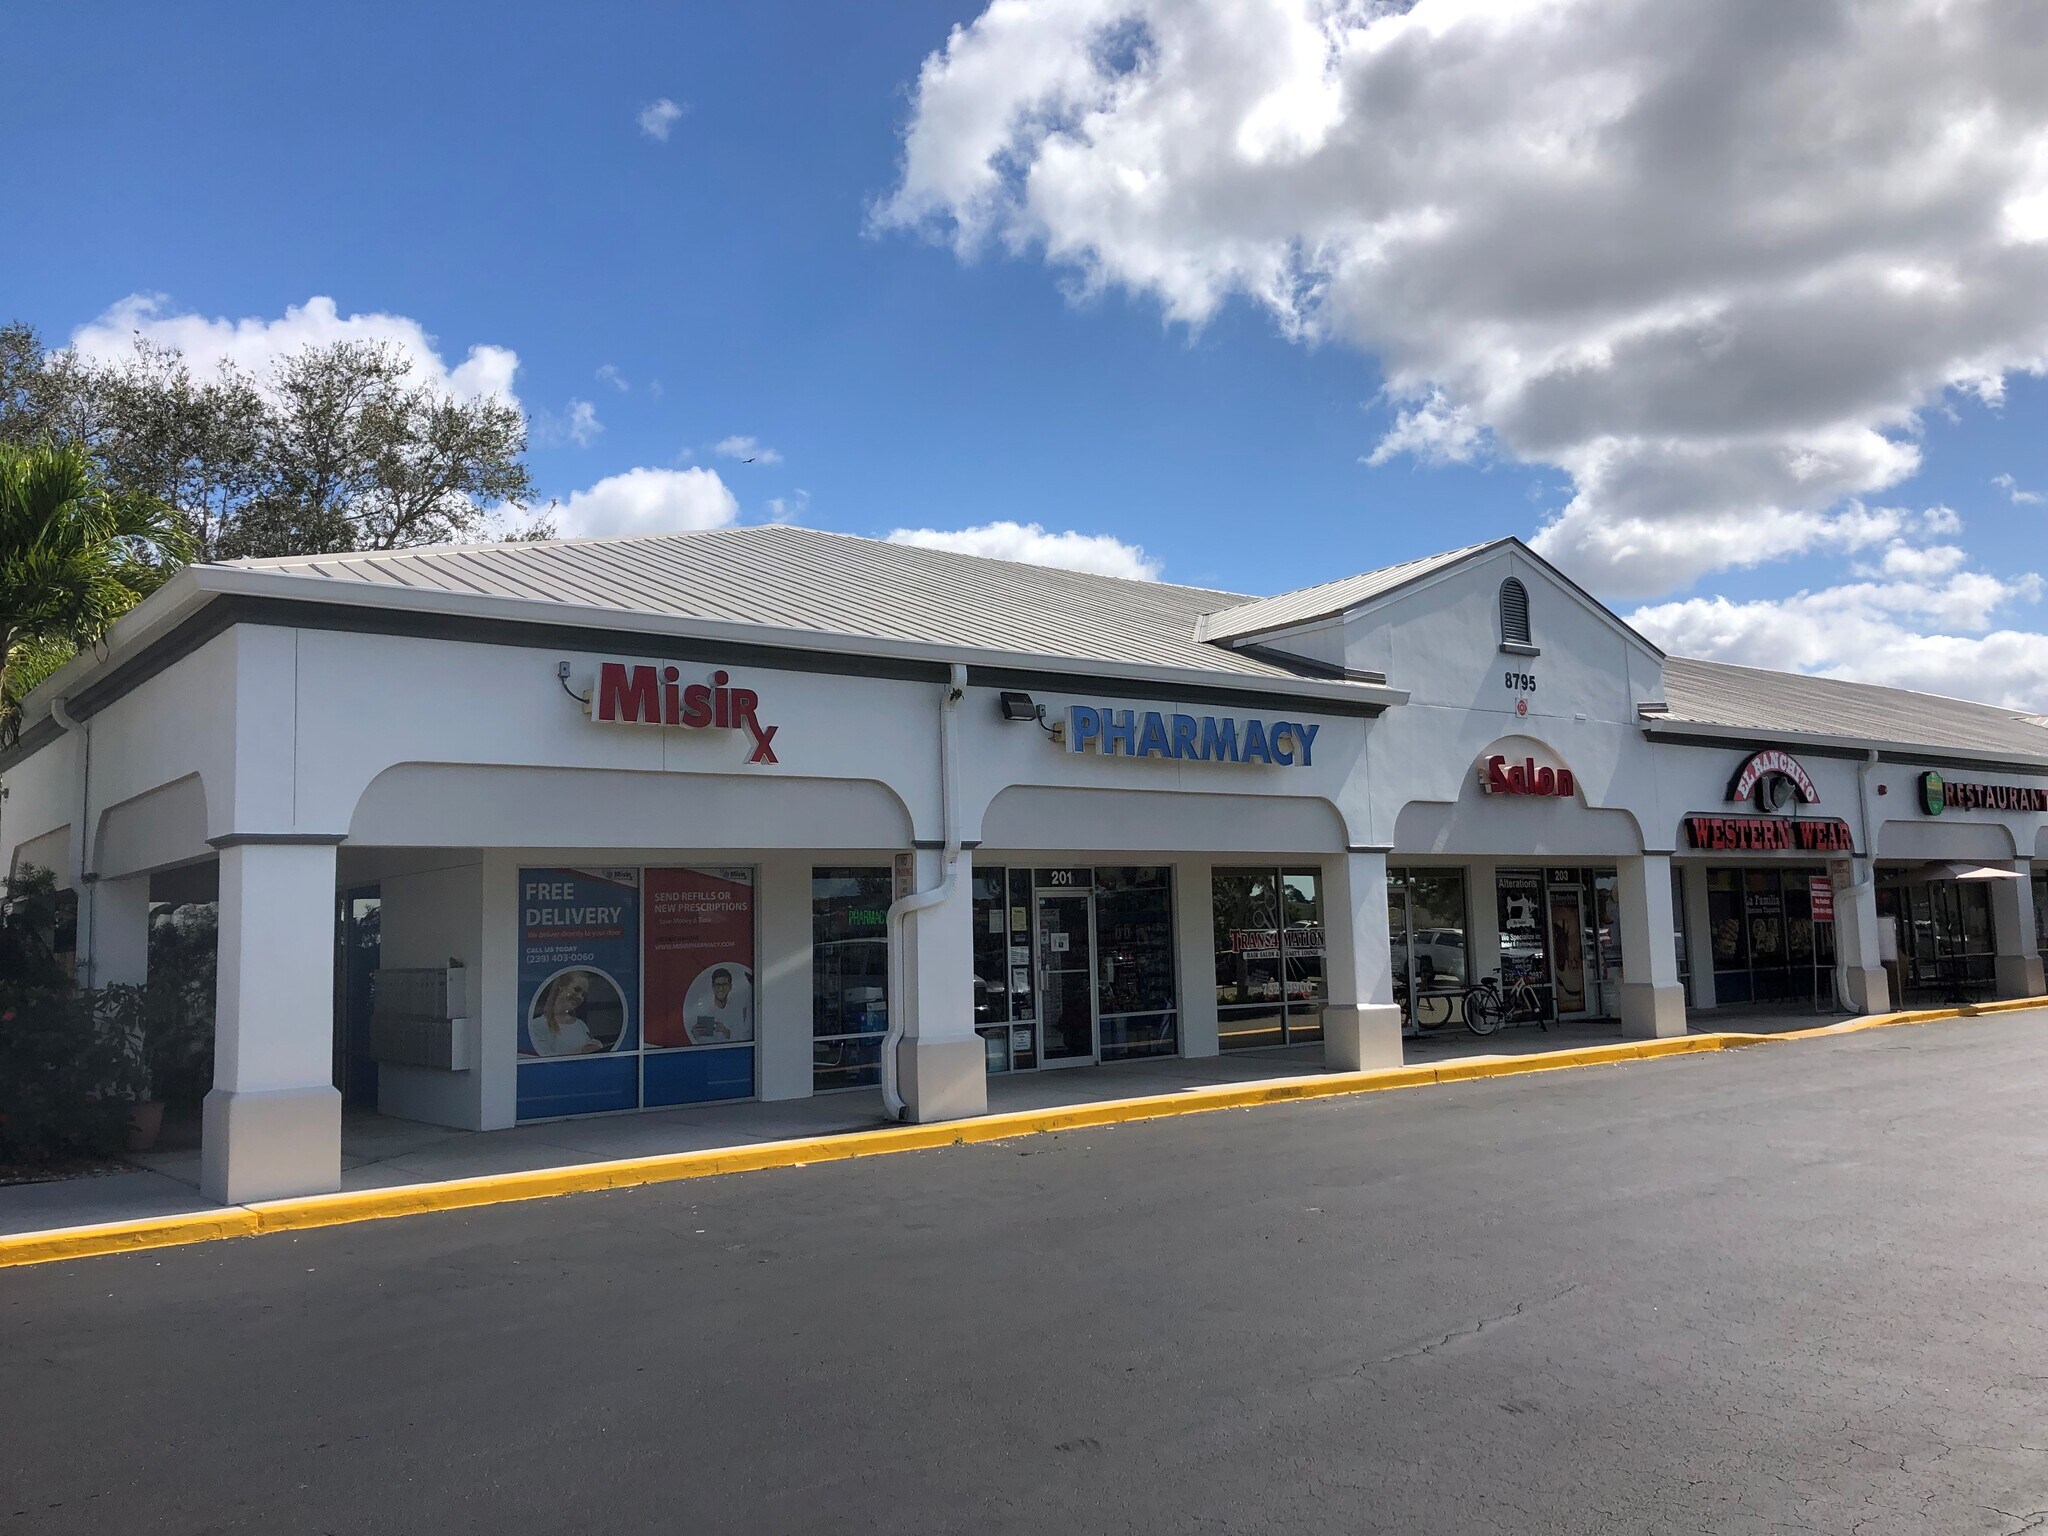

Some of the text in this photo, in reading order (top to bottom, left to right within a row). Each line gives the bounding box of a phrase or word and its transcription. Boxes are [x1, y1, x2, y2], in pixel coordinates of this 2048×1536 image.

[1504, 672, 1537, 691] 8795
[1067, 705, 1320, 766] PHARMACY
[1488, 755, 1575, 798] Salon
[1737, 751, 1815, 802] EL RANCHITO
[1691, 817, 1852, 850] WESTERN WEAR
[1051, 871, 1072, 884] 201
[1554, 870, 1569, 881] 203
[1498, 879, 1538, 888] Alterations
[526, 882, 575, 900] FREE
[655, 891, 732, 902] SEND REFILLS OR
[655, 902, 748, 913] NEW PRESCRIPTIONS
[526, 907, 623, 926] DELIVERY
[561, 929, 583, 939] directly
[584, 929, 593, 938] to
[556, 945, 578, 953] TODAY
[1260, 950, 1274, 958] SALON
[1301, 948, 1319, 956] LOUNGE
[526, 952, 594, 964] (239) 403-0060
